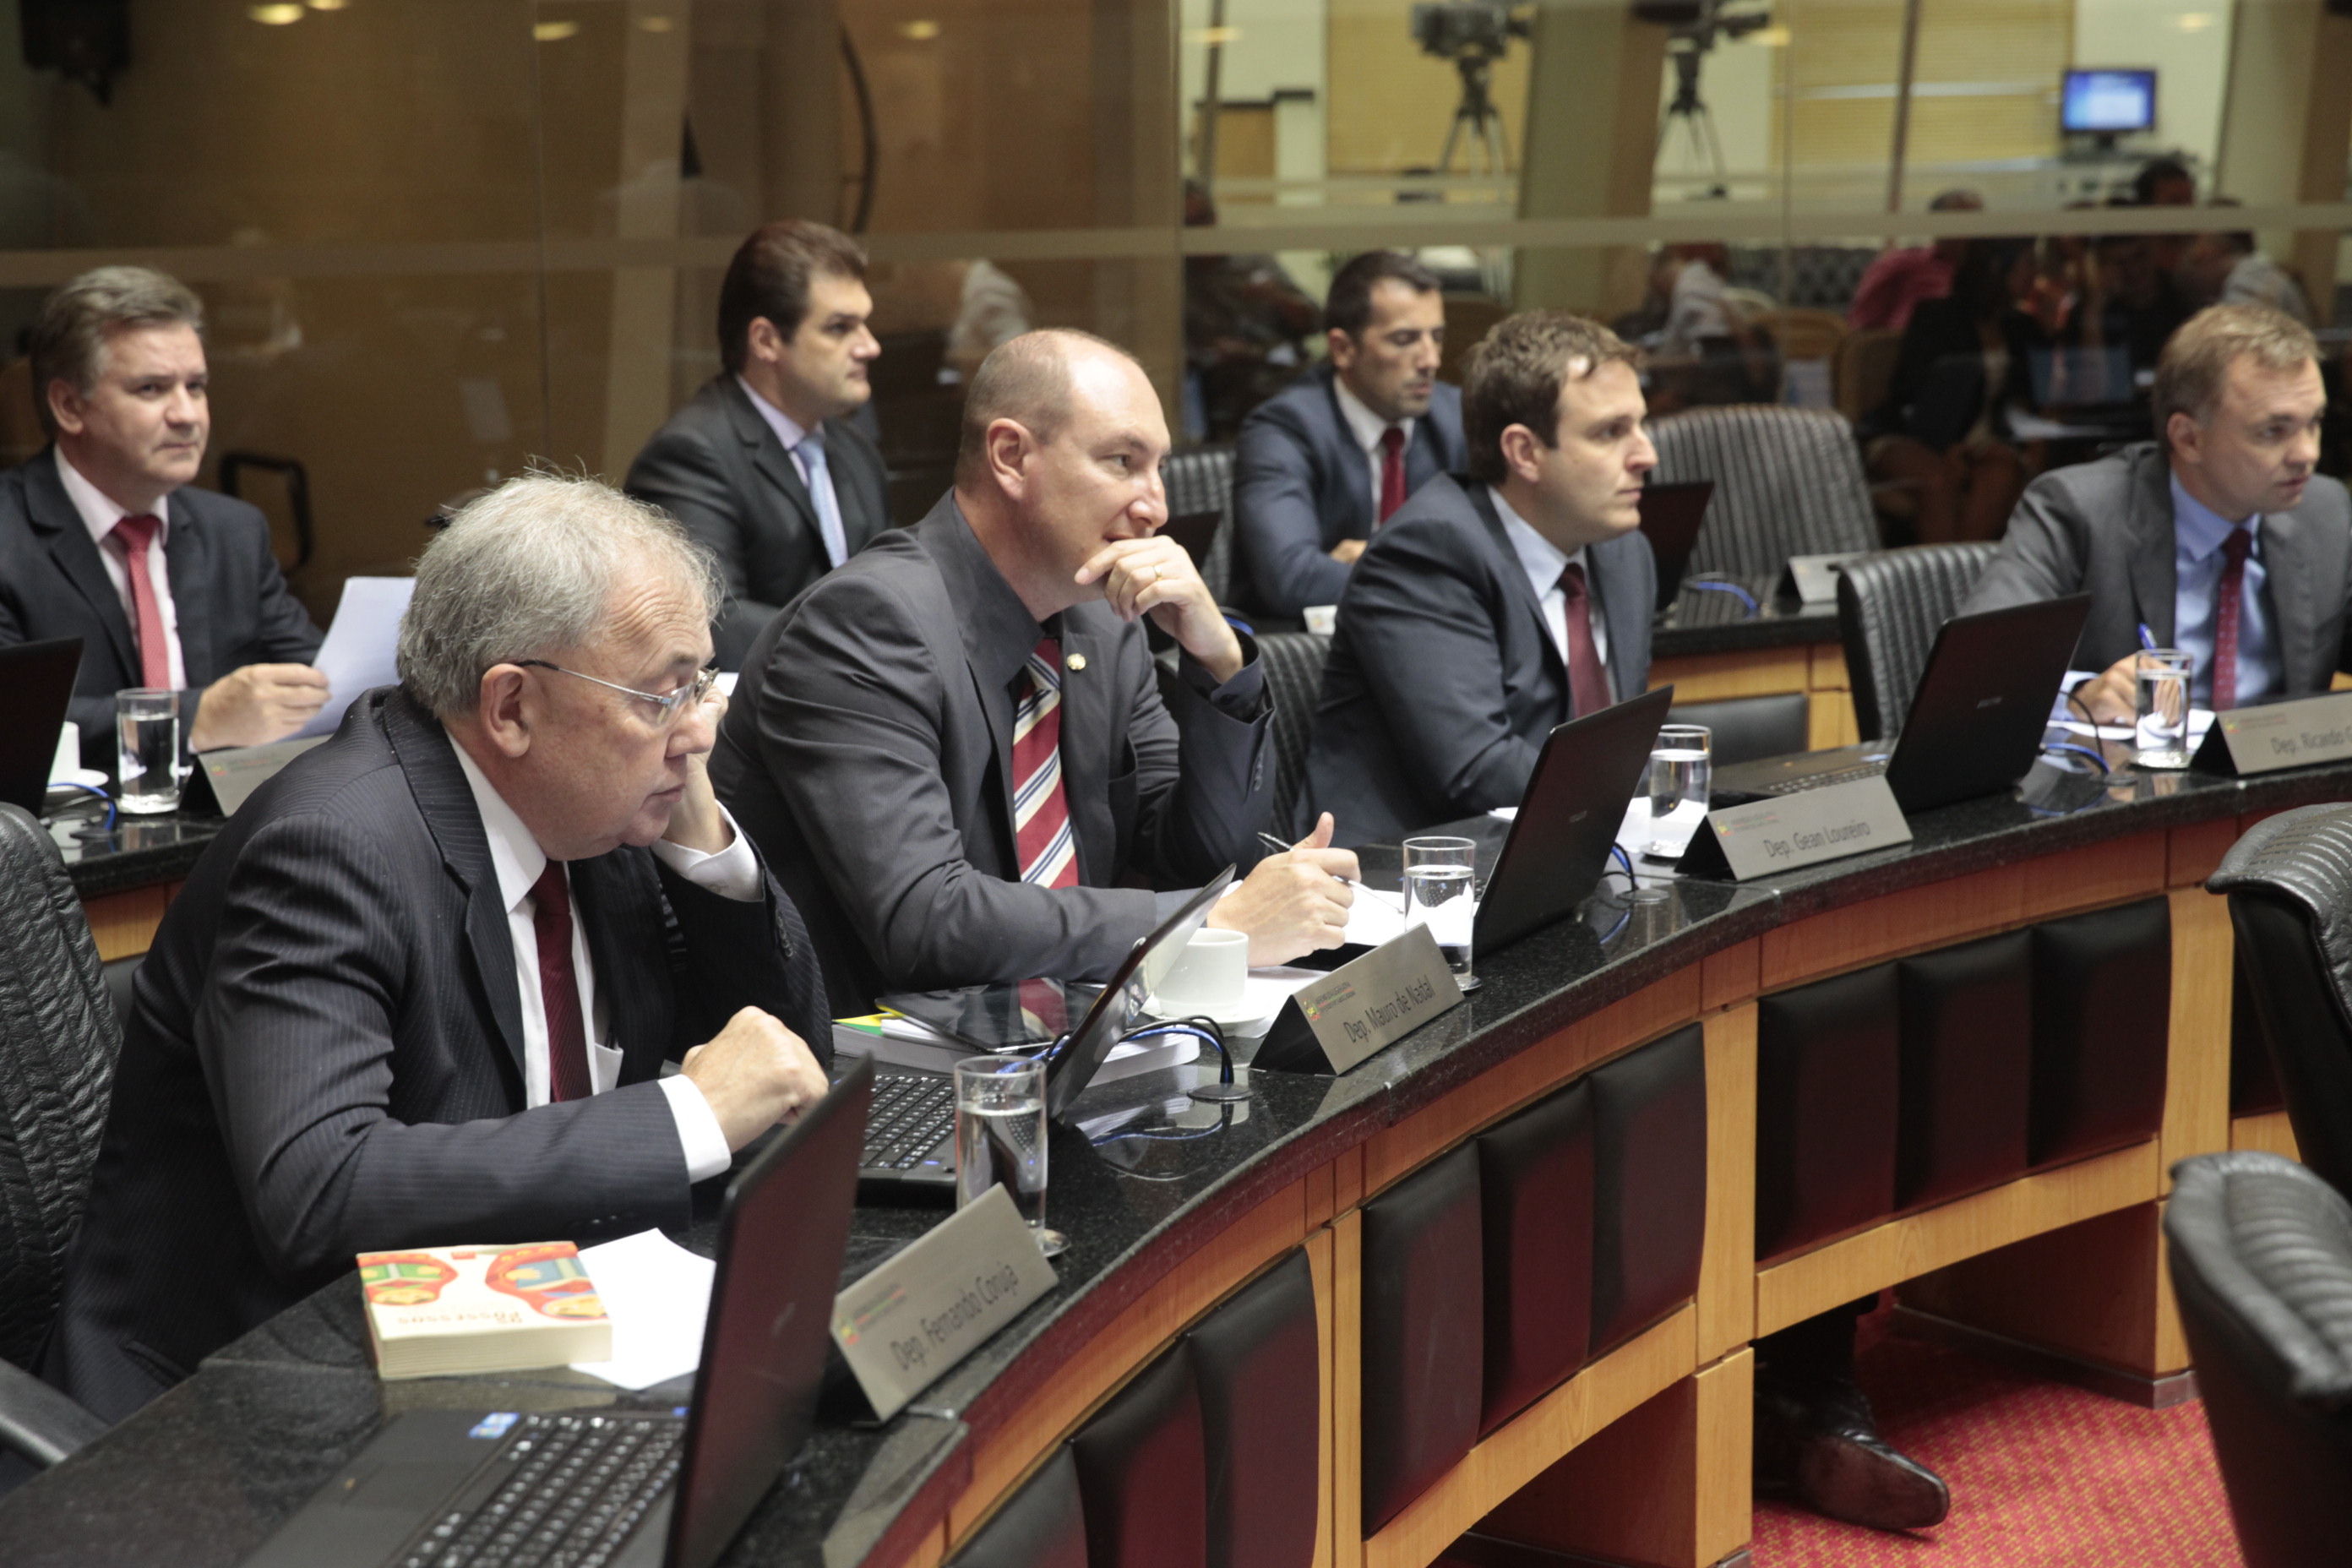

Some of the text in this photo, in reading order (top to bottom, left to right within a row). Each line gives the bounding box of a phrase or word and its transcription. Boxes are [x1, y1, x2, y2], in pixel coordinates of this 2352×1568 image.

[1762, 819, 1871, 859] Dep. Gean Loureiro
[1342, 973, 1436, 1043] Dep. Mauro de Nadal
[919, 1287, 983, 1348] Fernando
